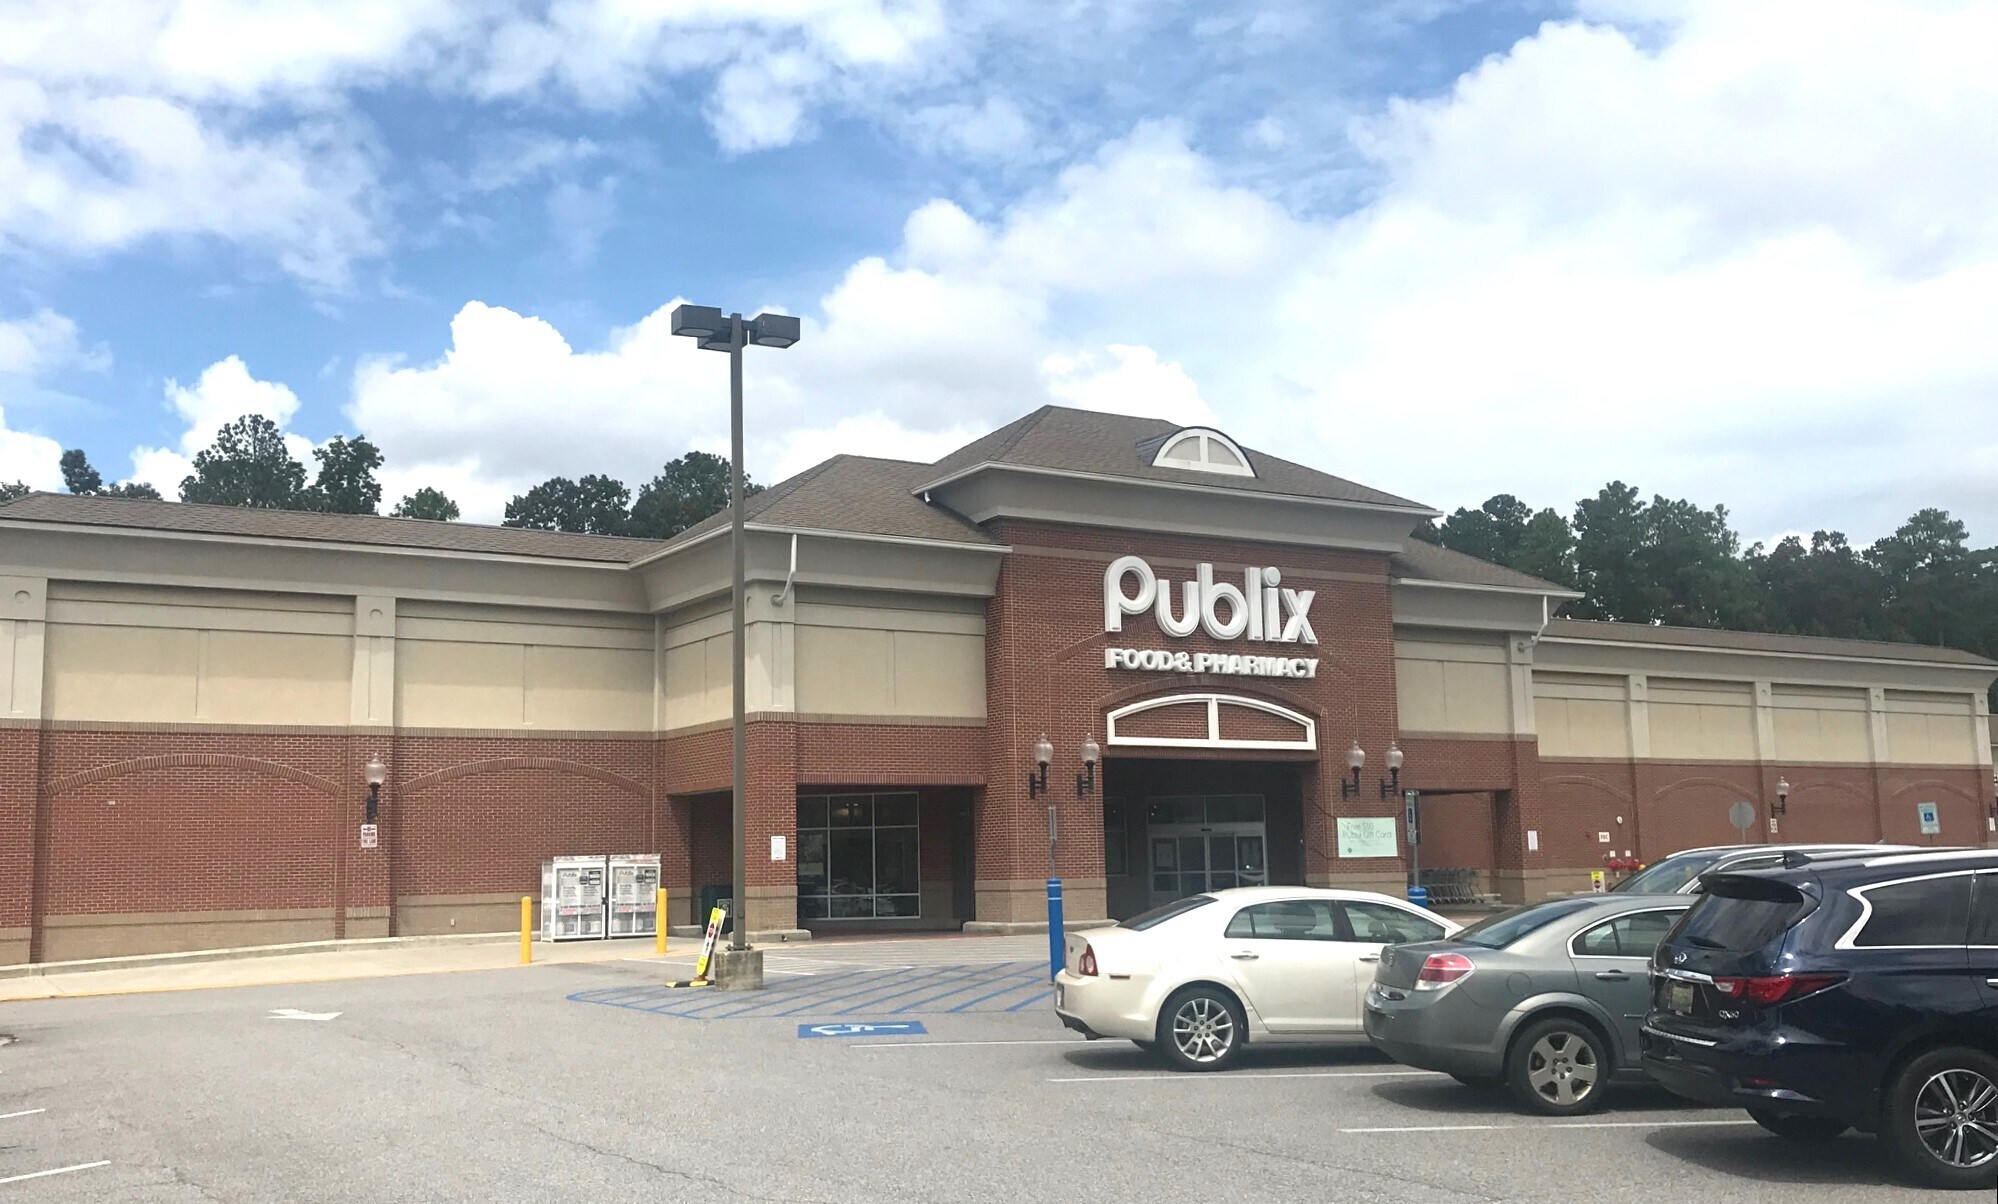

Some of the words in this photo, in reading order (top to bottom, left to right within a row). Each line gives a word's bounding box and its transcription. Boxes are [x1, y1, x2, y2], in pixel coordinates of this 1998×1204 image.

[1104, 556, 1318, 644] Publix
[1193, 653, 1319, 678] PHARMACY
[1375, 830, 1392, 839] Card
